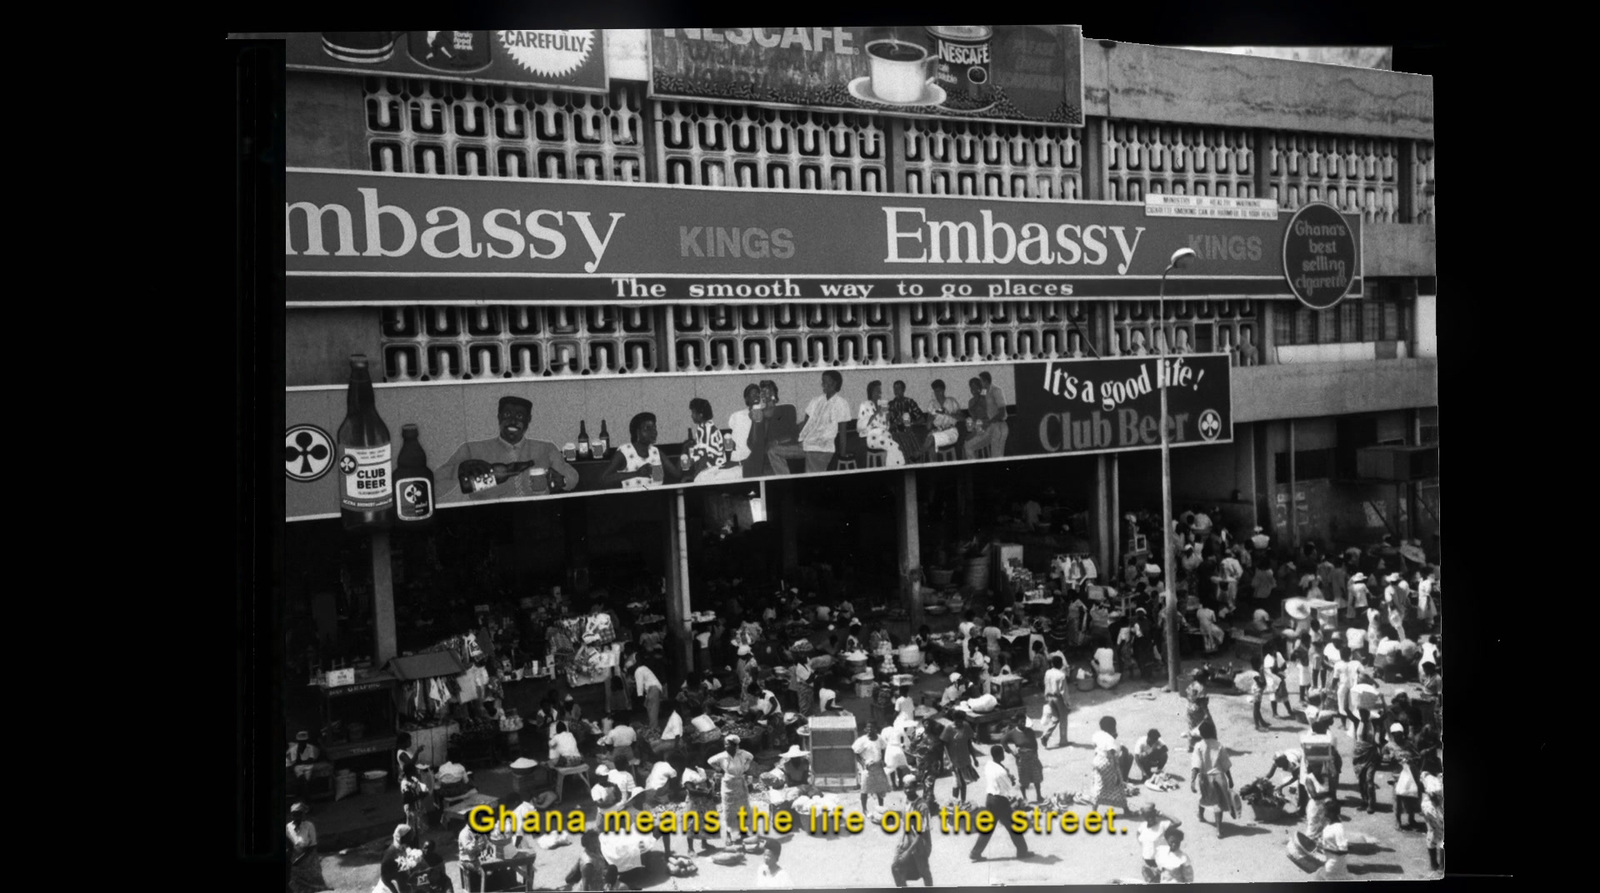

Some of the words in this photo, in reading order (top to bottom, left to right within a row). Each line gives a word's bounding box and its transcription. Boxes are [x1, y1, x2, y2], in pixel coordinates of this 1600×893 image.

[505, 30, 586, 52] CAREFULLY
[1295, 220, 1346, 236] Ghana's
[679, 225, 795, 260] KINGS
[882, 206, 1146, 275] Embassy
[1188, 234, 1263, 261] KINGS
[1309, 239, 1337, 254] best
[1302, 255, 1346, 278] selling
[611, 278, 667, 298] The
[689, 278, 801, 298] smooth
[820, 283, 875, 299] way
[898, 280, 925, 297] to
[941, 282, 973, 298] go
[988, 279, 1074, 298] places
[1043, 362, 1079, 400] It's
[1081, 379, 1096, 403] a
[1101, 363, 1153, 412] good
[1039, 409, 1112, 452] Club
[1118, 408, 1190, 447] Beer
[357, 469, 385, 479] CLUB
[357, 479, 385, 489] BEER
